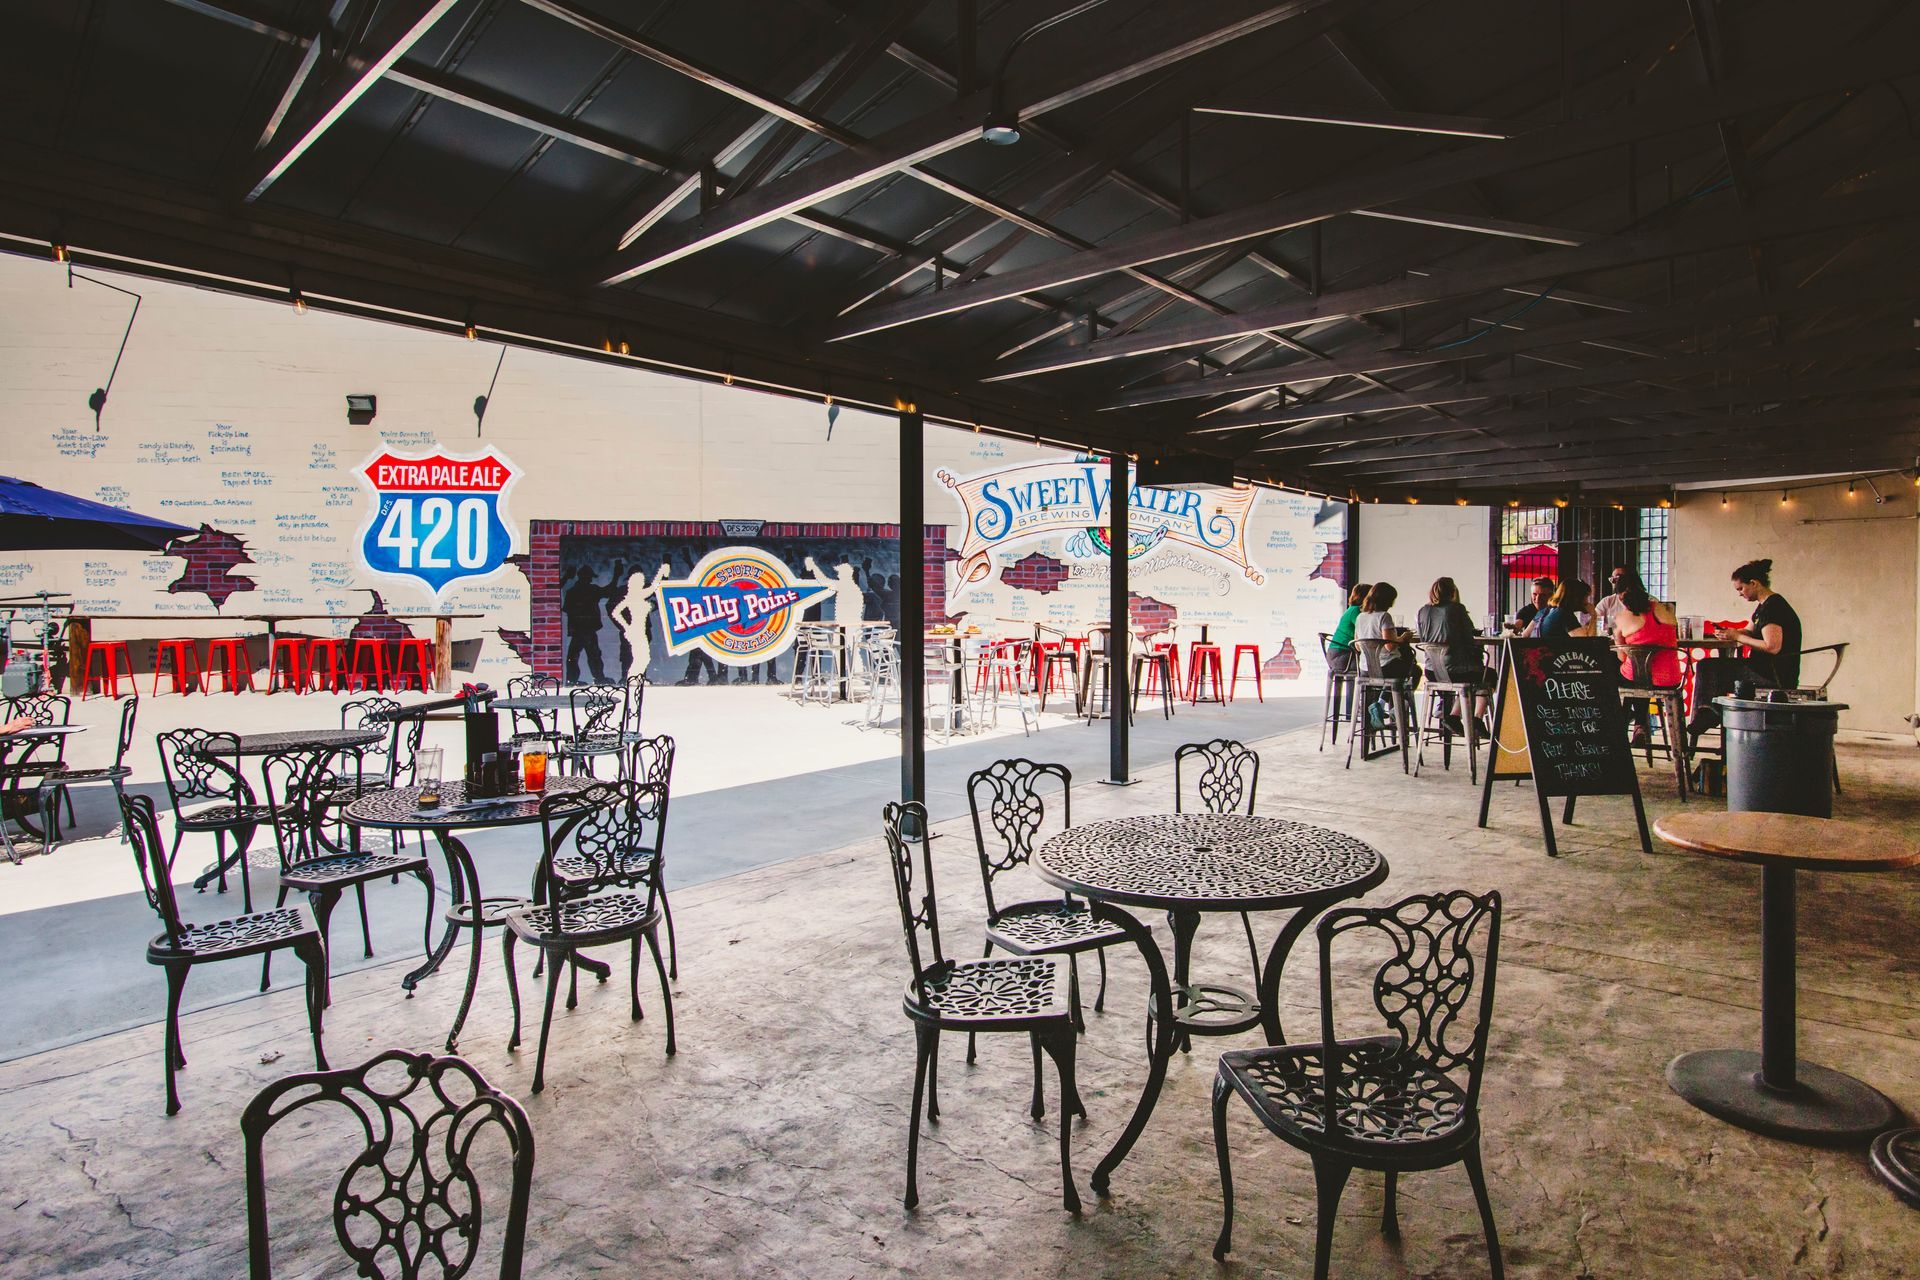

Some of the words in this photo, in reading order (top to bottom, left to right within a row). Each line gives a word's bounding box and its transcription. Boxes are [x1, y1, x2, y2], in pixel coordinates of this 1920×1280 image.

[378, 465, 430, 486] EXTRA
[431, 465, 468, 487] PALE
[470, 466, 501, 487] ALE
[726, 524, 741, 532] DFS
[1018, 510, 1090, 527] BREWING
[1130, 512, 1193, 531] OMPANY
[377, 497, 489, 569] 420
[1532, 526, 1549, 539] EXIT
[715, 564, 765, 583] SPORT
[669, 594, 740, 632] Rally
[743, 590, 799, 620] Point
[723, 629, 777, 650] GRILL
[1553, 651, 1598, 669] FIREBALL
[1545, 678, 1595, 700] PLEASE
[1536, 704, 1560, 719] SEE
[1565, 706, 1602, 719] INSIDE
[1581, 720, 1600, 734] FOR
